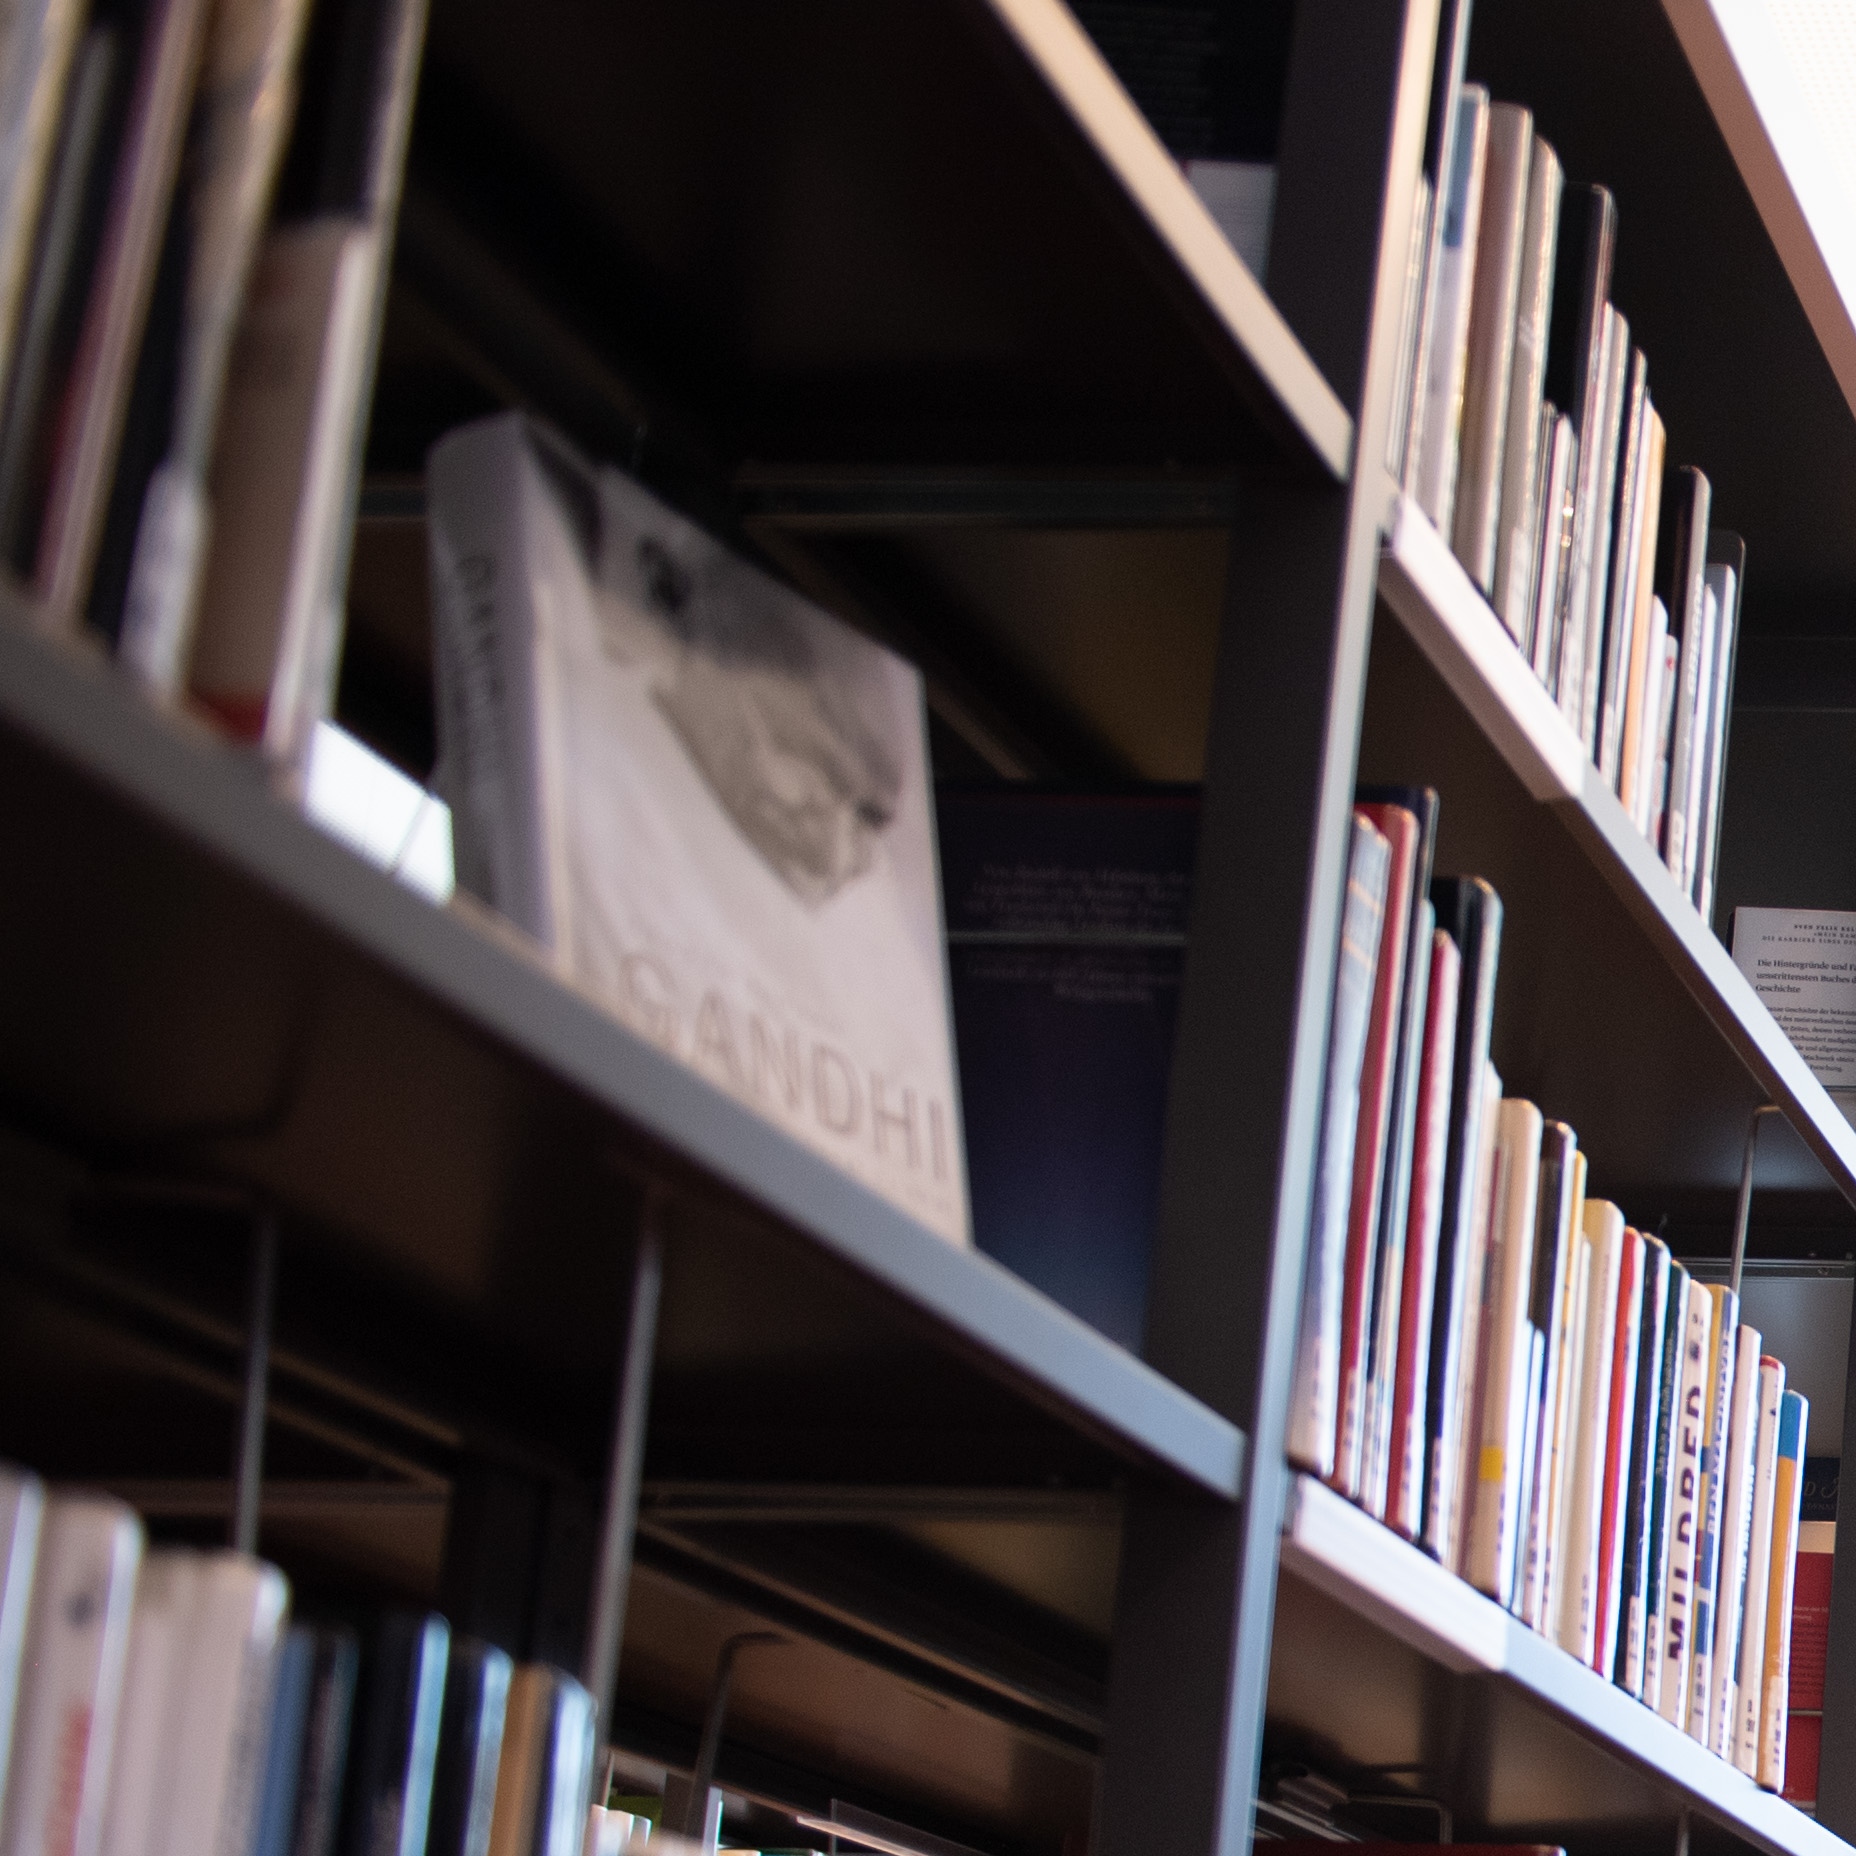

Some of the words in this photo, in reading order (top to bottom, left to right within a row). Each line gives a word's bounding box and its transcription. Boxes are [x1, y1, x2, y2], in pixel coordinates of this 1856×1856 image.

[1757, 959, 1771, 967] Die
[1773, 960, 1830, 972] Hintergründe
[1756, 972, 1819, 983] umstrittensten
[1755, 984, 1801, 993] Geschichte
[615, 948, 951, 1177] GANDHI
[1667, 1386, 1701, 1660] MILDRED
